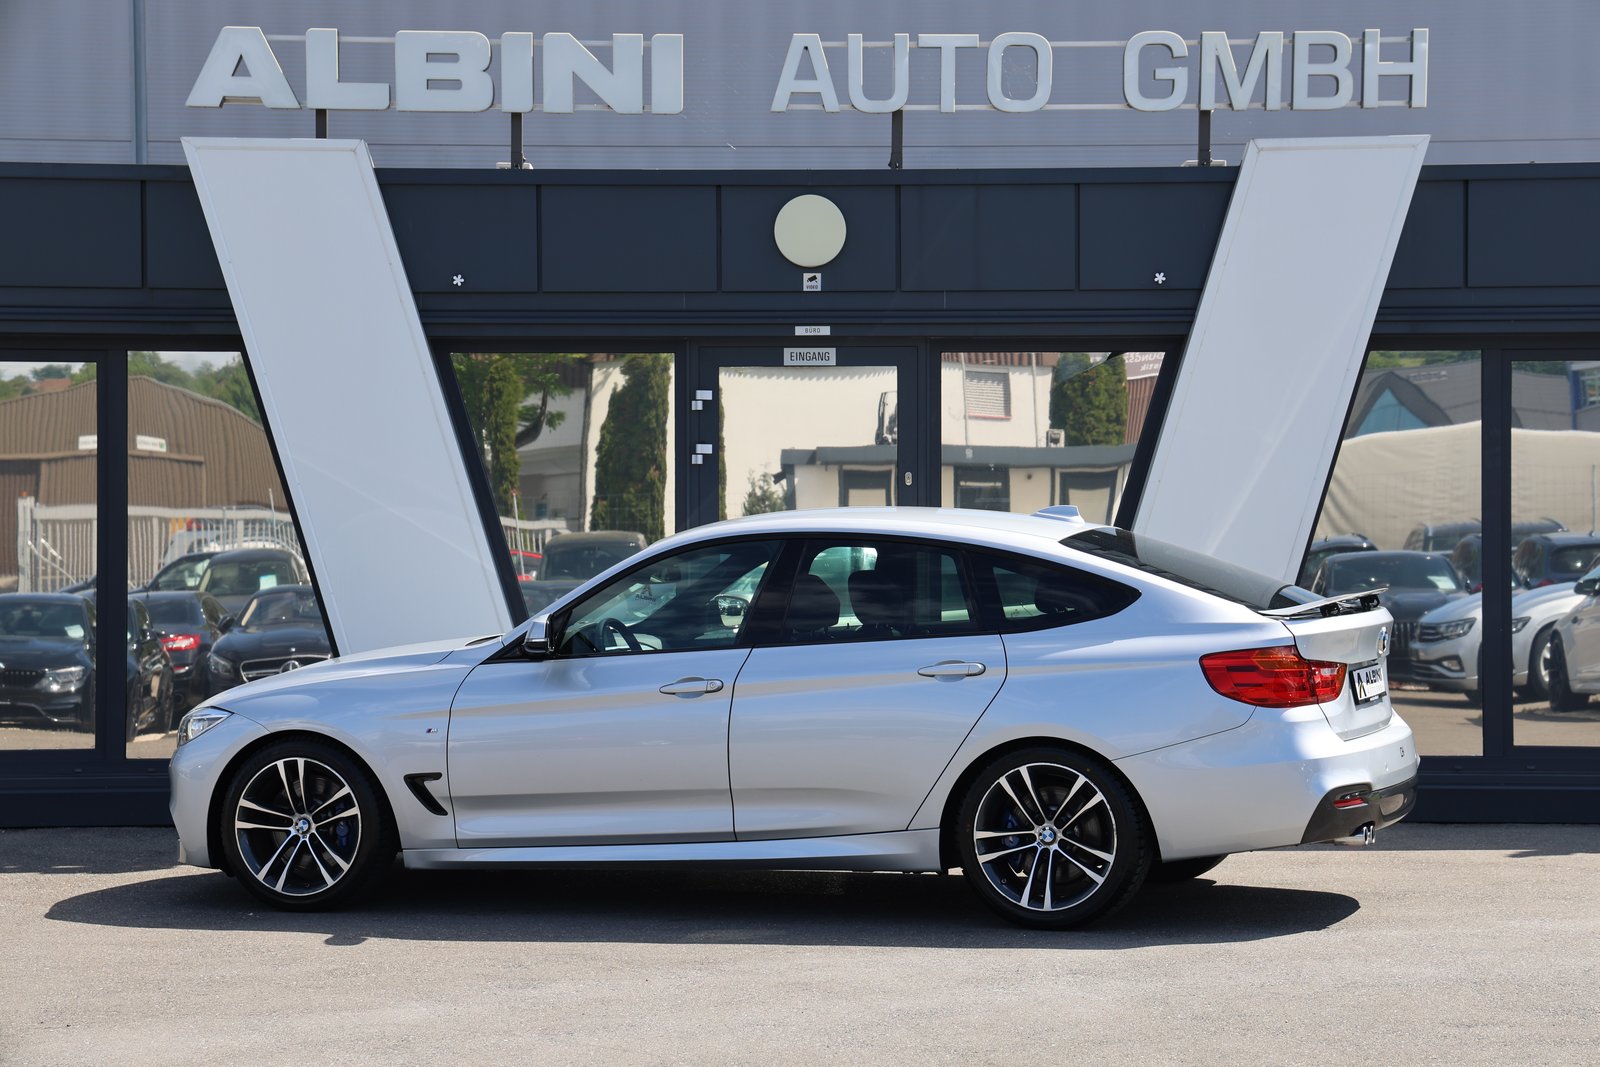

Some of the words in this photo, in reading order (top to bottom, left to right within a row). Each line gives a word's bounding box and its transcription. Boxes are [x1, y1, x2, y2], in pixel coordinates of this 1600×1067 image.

[185, 26, 684, 114] ALBINI
[770, 31, 1053, 113] AUTO
[1122, 28, 1429, 112] GMBH
[790, 352, 830, 361] EINGANG
